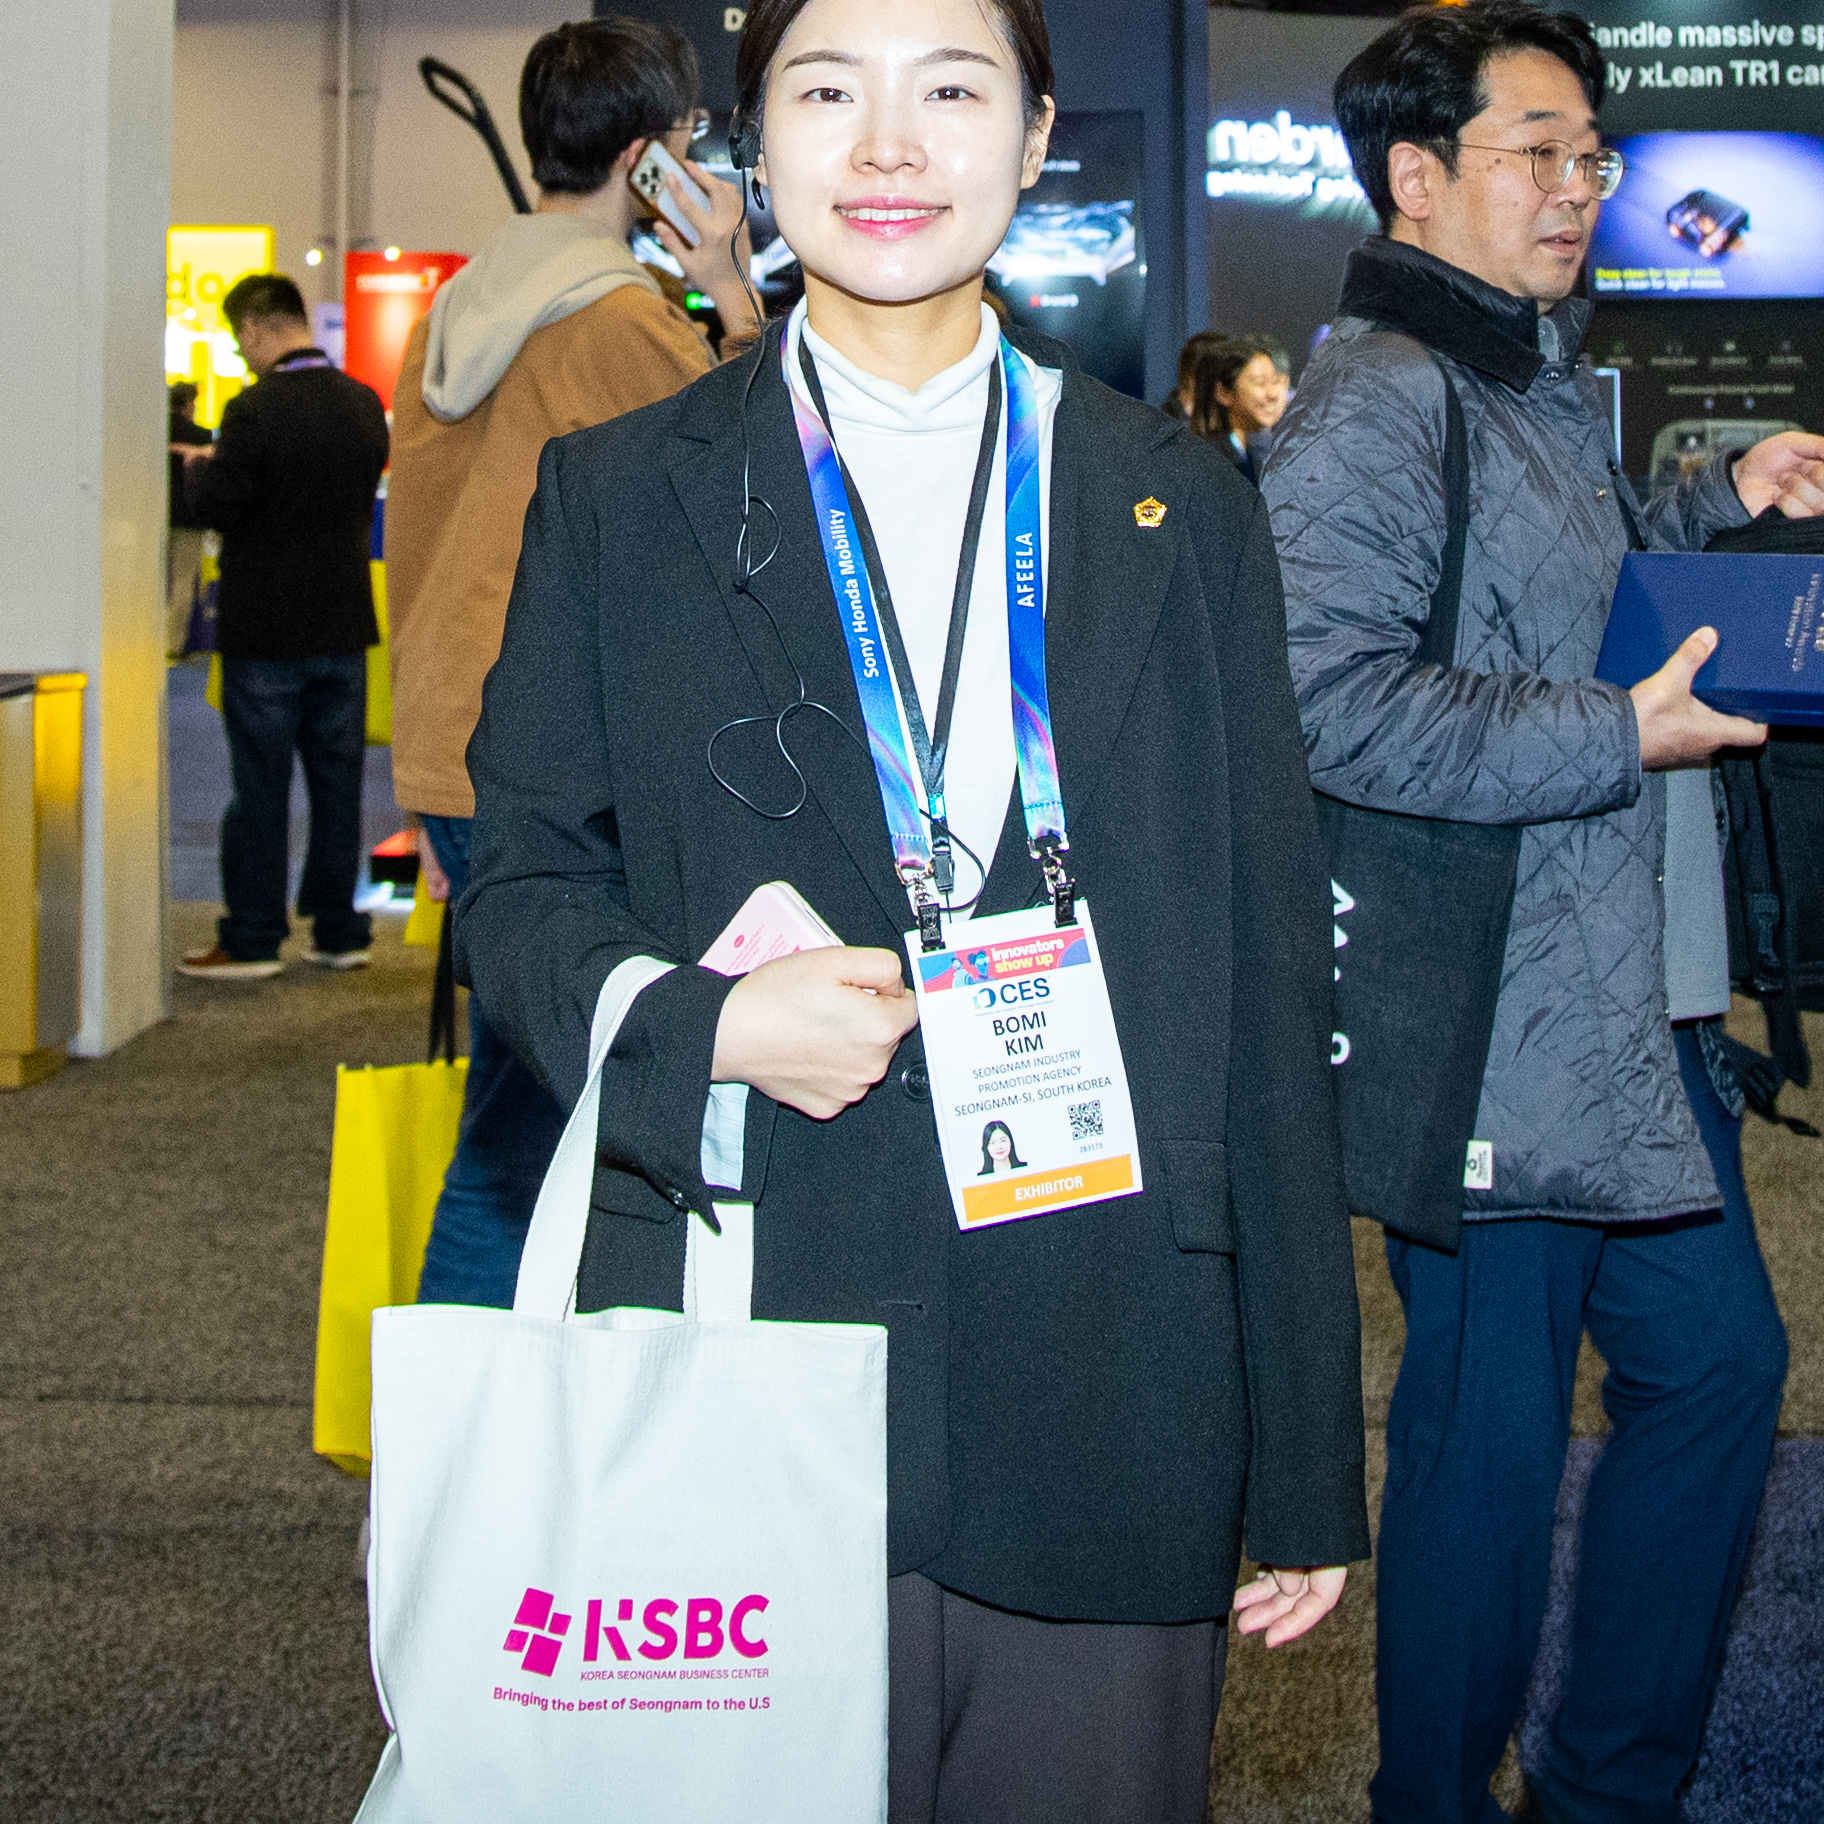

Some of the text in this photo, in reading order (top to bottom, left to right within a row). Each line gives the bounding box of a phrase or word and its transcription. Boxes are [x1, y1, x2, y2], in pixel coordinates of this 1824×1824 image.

[1587, 20, 1674, 49] andle
[1677, 18, 1795, 49] massive
[1637, 60, 1724, 89] xLean
[1015, 531, 1035, 608] AFEELA
[829, 508, 880, 679] Sony Honda Mobility
[990, 938, 1066, 962] innovators
[994, 952, 1055, 974] show up
[999, 977, 1051, 1004] CES
[992, 1010, 1048, 1037] BOMI
[1004, 1033, 1045, 1057] KIM
[972, 1049, 1082, 1080] SEONGNAM INDUSTRY
[977, 1065, 1082, 1095] PROMOTION AGENCY
[954, 1076, 1113, 1117] SEONGNAM-SI, SOUTH KOREA
[1014, 1174, 1085, 1202] EXHIBITOR
[582, 1594, 771, 1663] KSBC
[580, 1667, 770, 1682] KOREA SEONGNAM BUSINESS CENTER
[492, 1686, 771, 1713] Bringing the best of Seongnam to the U.S
